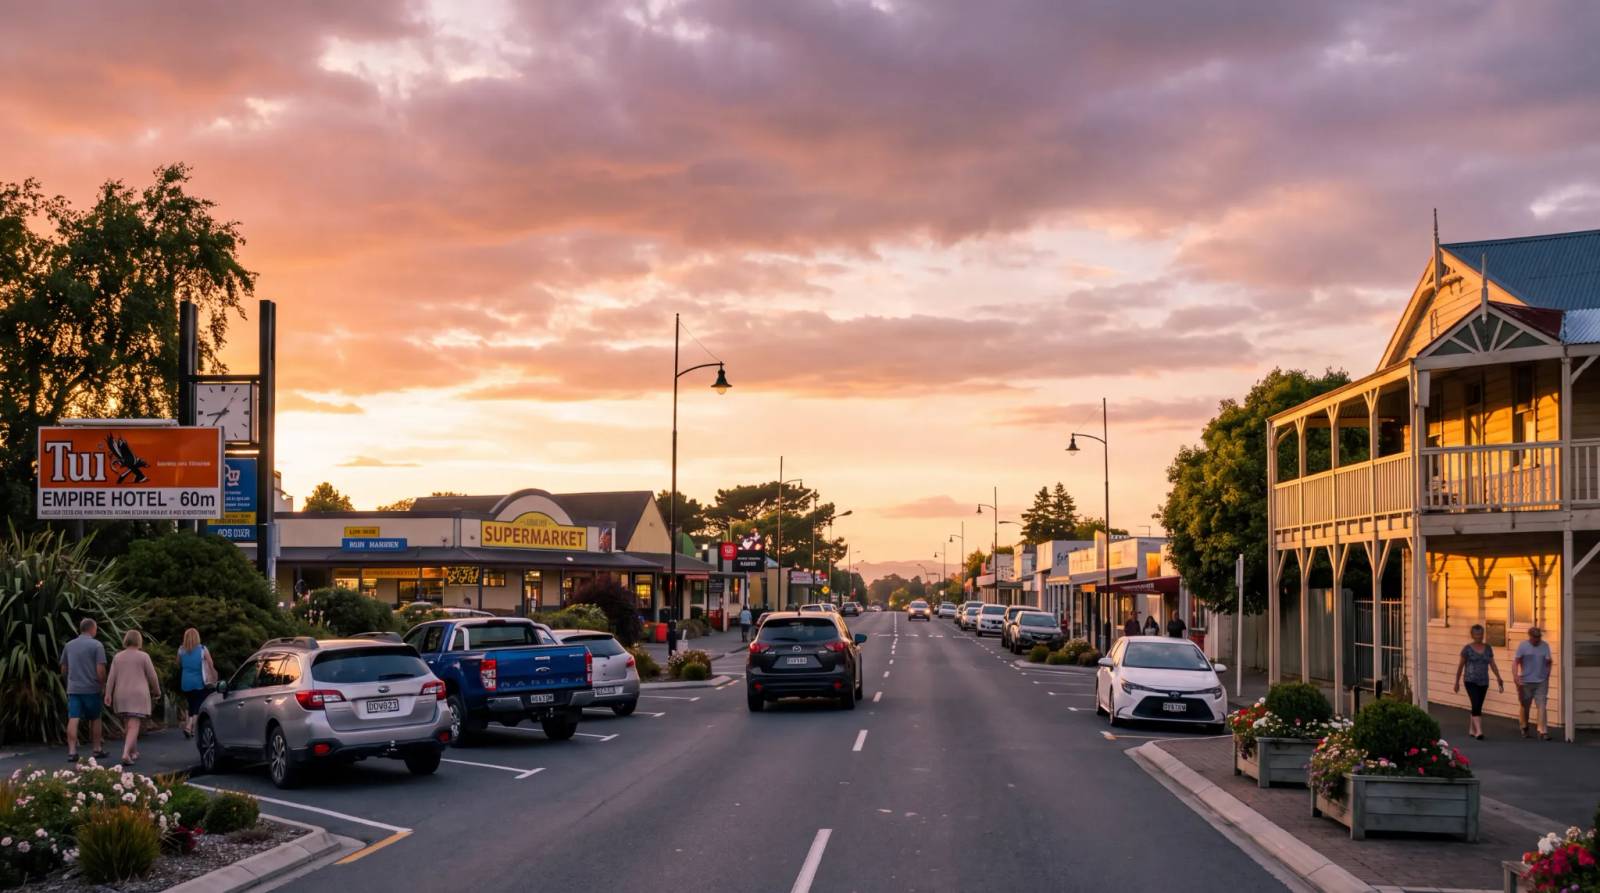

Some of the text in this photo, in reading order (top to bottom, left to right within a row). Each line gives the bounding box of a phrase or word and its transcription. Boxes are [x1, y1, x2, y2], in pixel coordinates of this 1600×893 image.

[46, 441, 106, 482] Tui
[42, 491, 106, 507] EMPIRE
[111, 491, 167, 507] HOTEL
[180, 491, 215, 507] 60m
[484, 526, 584, 546] SUPERMARKET
